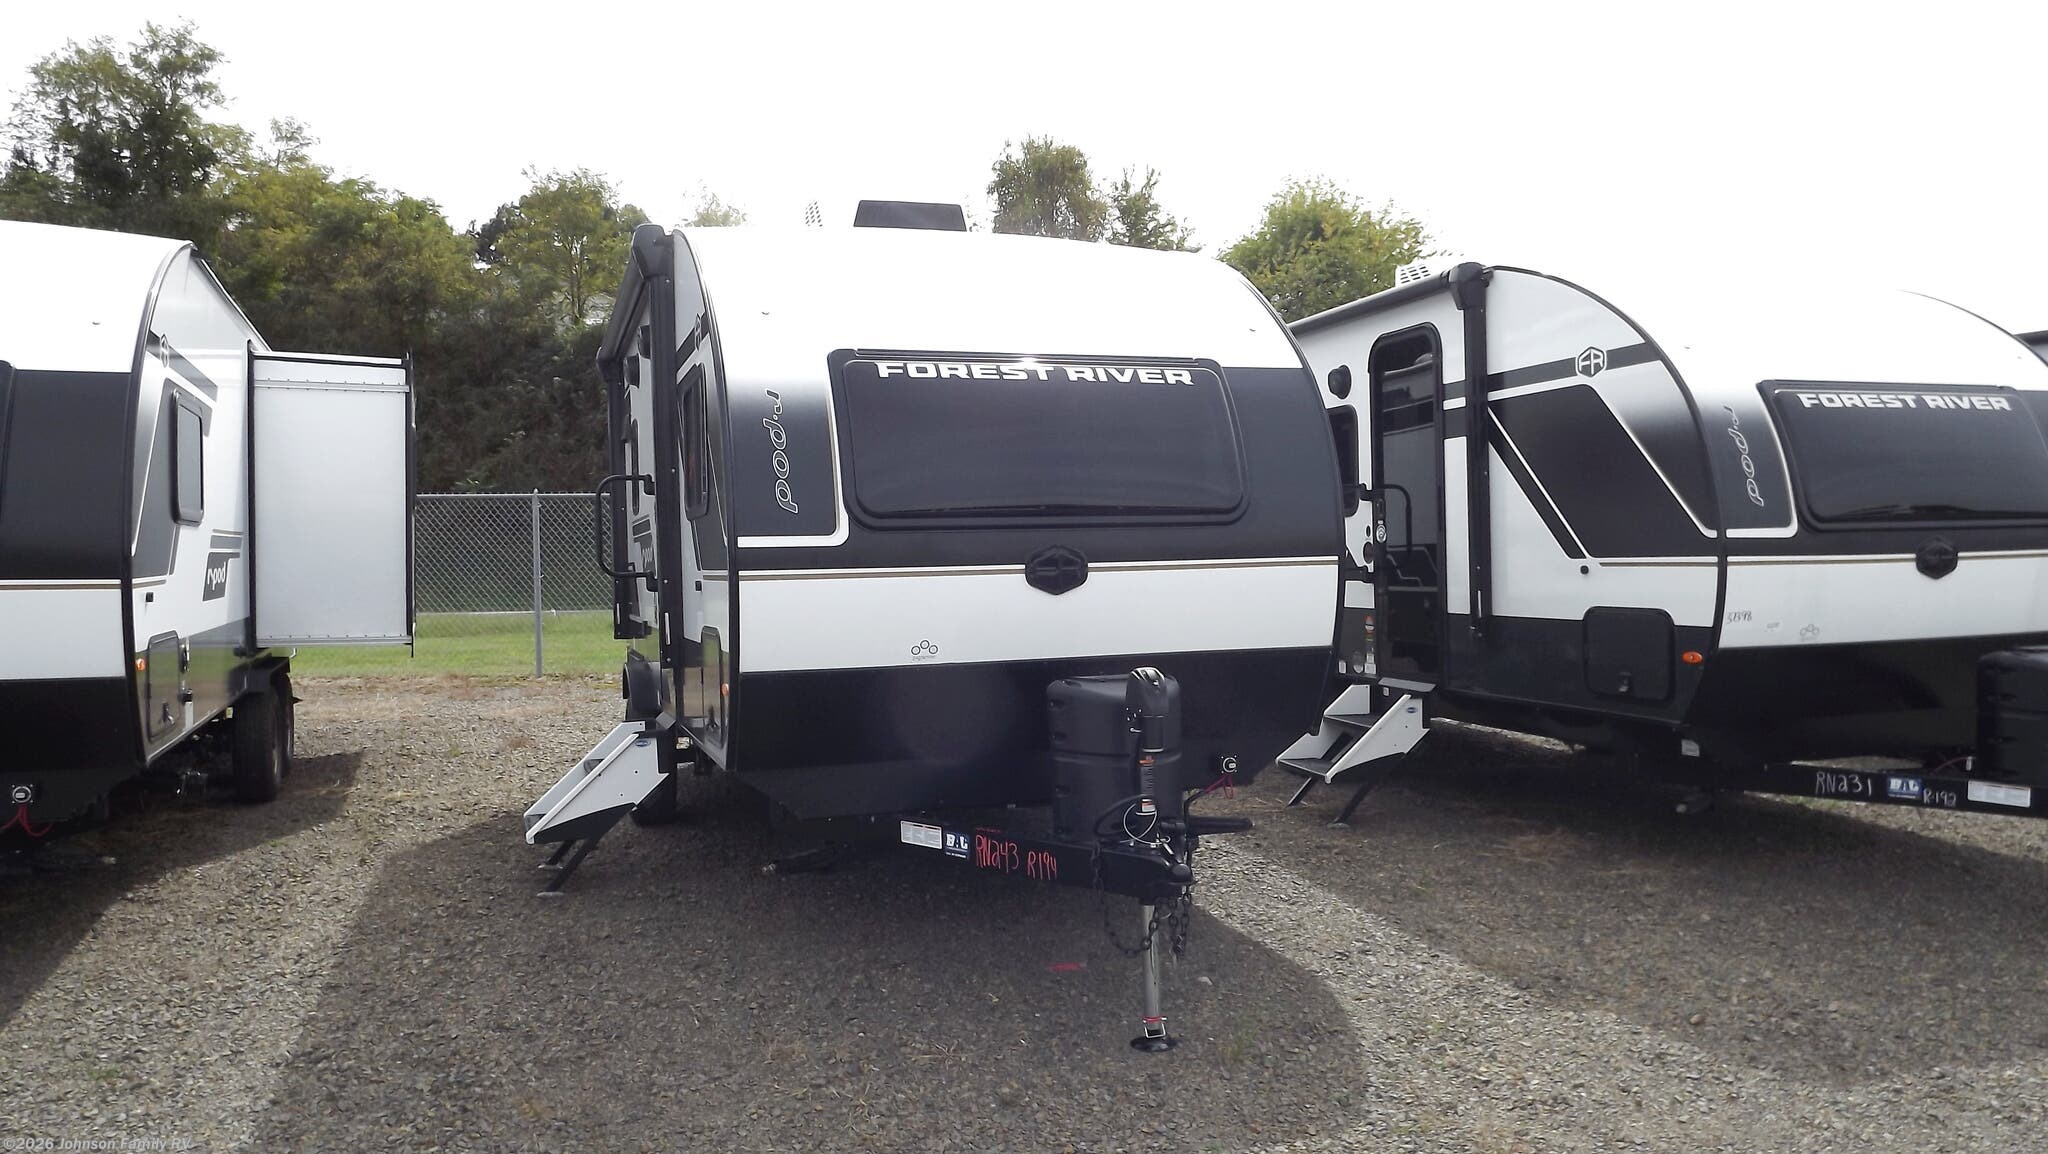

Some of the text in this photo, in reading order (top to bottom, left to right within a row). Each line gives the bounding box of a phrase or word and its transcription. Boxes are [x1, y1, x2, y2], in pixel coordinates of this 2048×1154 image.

[874, 361, 1195, 386] FOREST RIVER
[1797, 392, 2012, 411] FOREST RIVER
[1815, 771, 1872, 797] RN231
[975, 834, 1019, 873] RN243
[1027, 851, 1058, 881] R194
